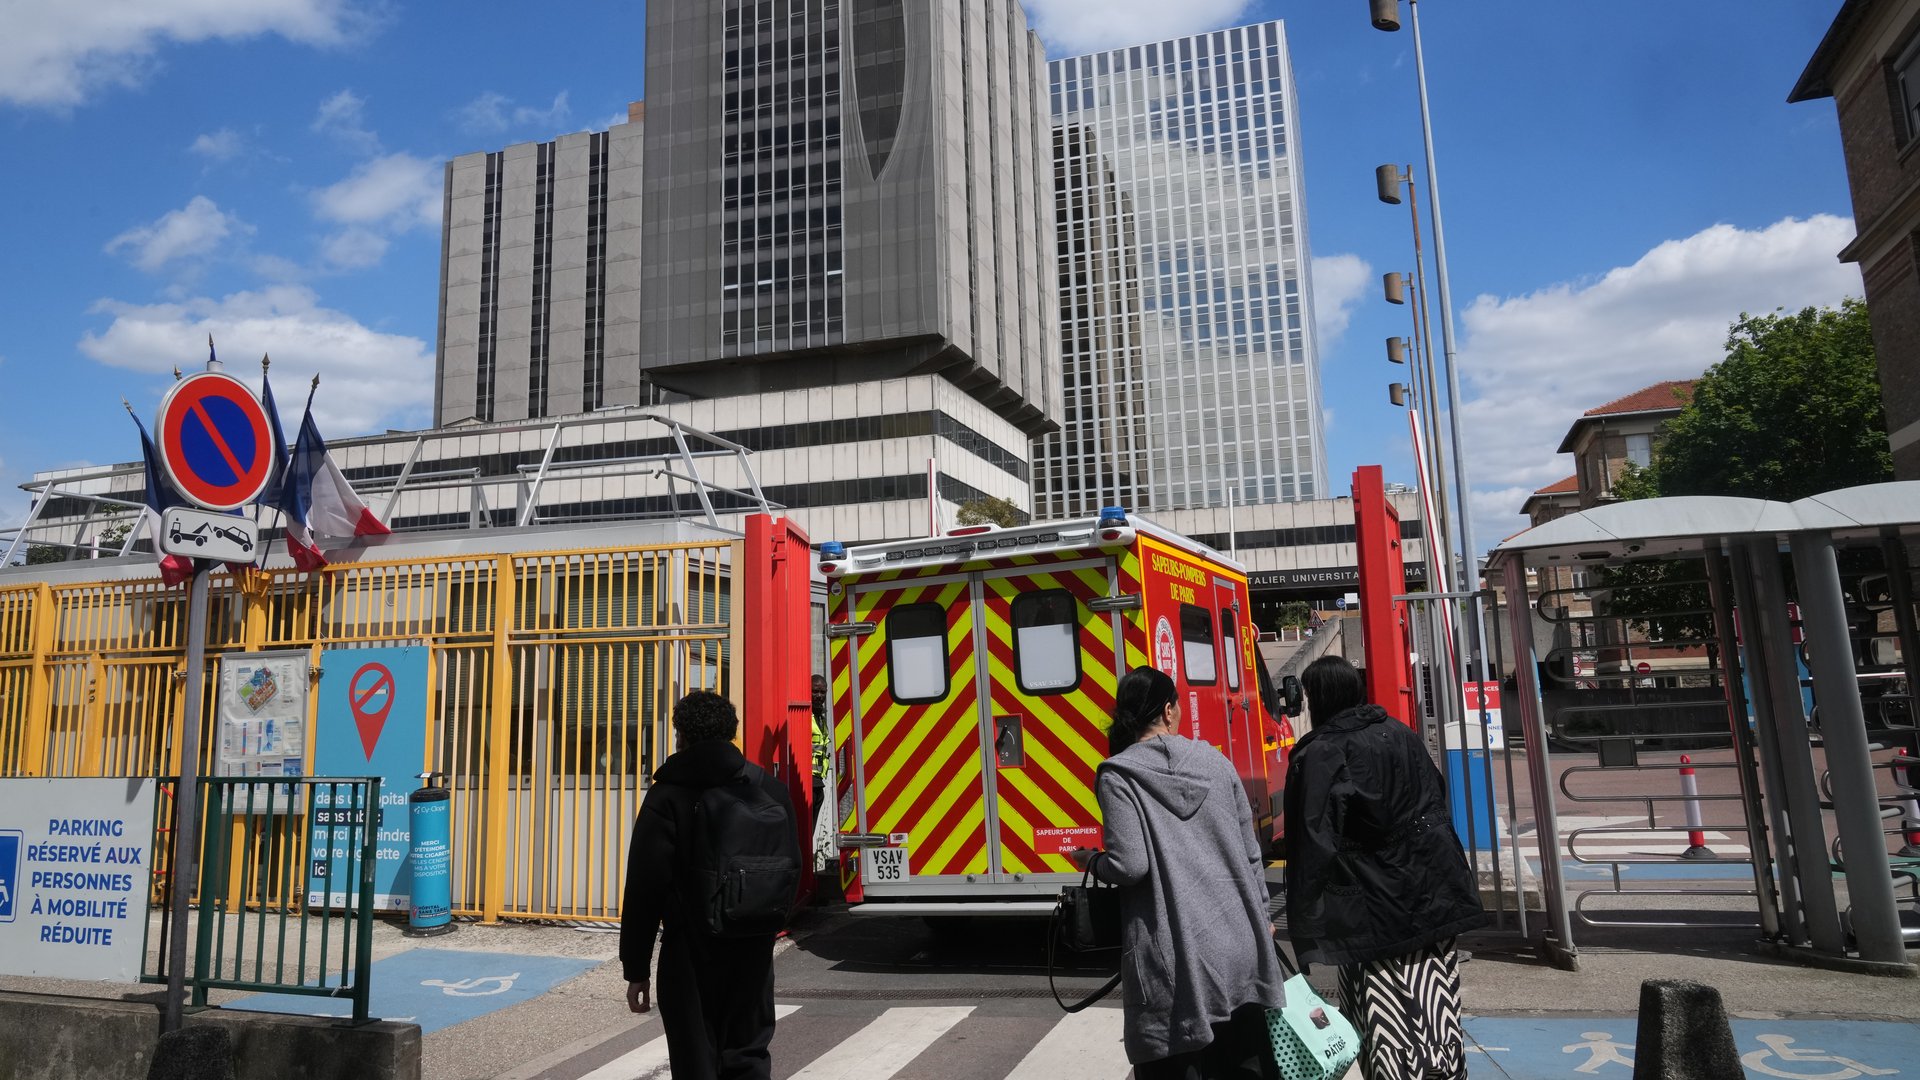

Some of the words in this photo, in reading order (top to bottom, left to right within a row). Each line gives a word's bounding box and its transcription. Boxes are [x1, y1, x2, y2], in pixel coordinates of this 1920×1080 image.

[1152, 553, 1207, 587] SAPEURS-POMPIERS
[1170, 582, 1179, 600] DE
[1179, 585, 1195, 605] PARIS
[375, 792, 408, 807] pital
[48, 818, 124, 837] PARKING
[1036, 828, 1098, 836] SAPEURS-POMPIERS
[27, 840, 101, 863] RÉSERVÉ
[105, 847, 142, 864] AUX
[873, 850, 902, 864] VSAV
[31, 871, 133, 892] PERSONNES
[877, 865, 900, 880] 535
[30, 893, 43, 915] À
[47, 897, 128, 919] MOBILITÉ
[40, 921, 113, 946] RÉDUITE
